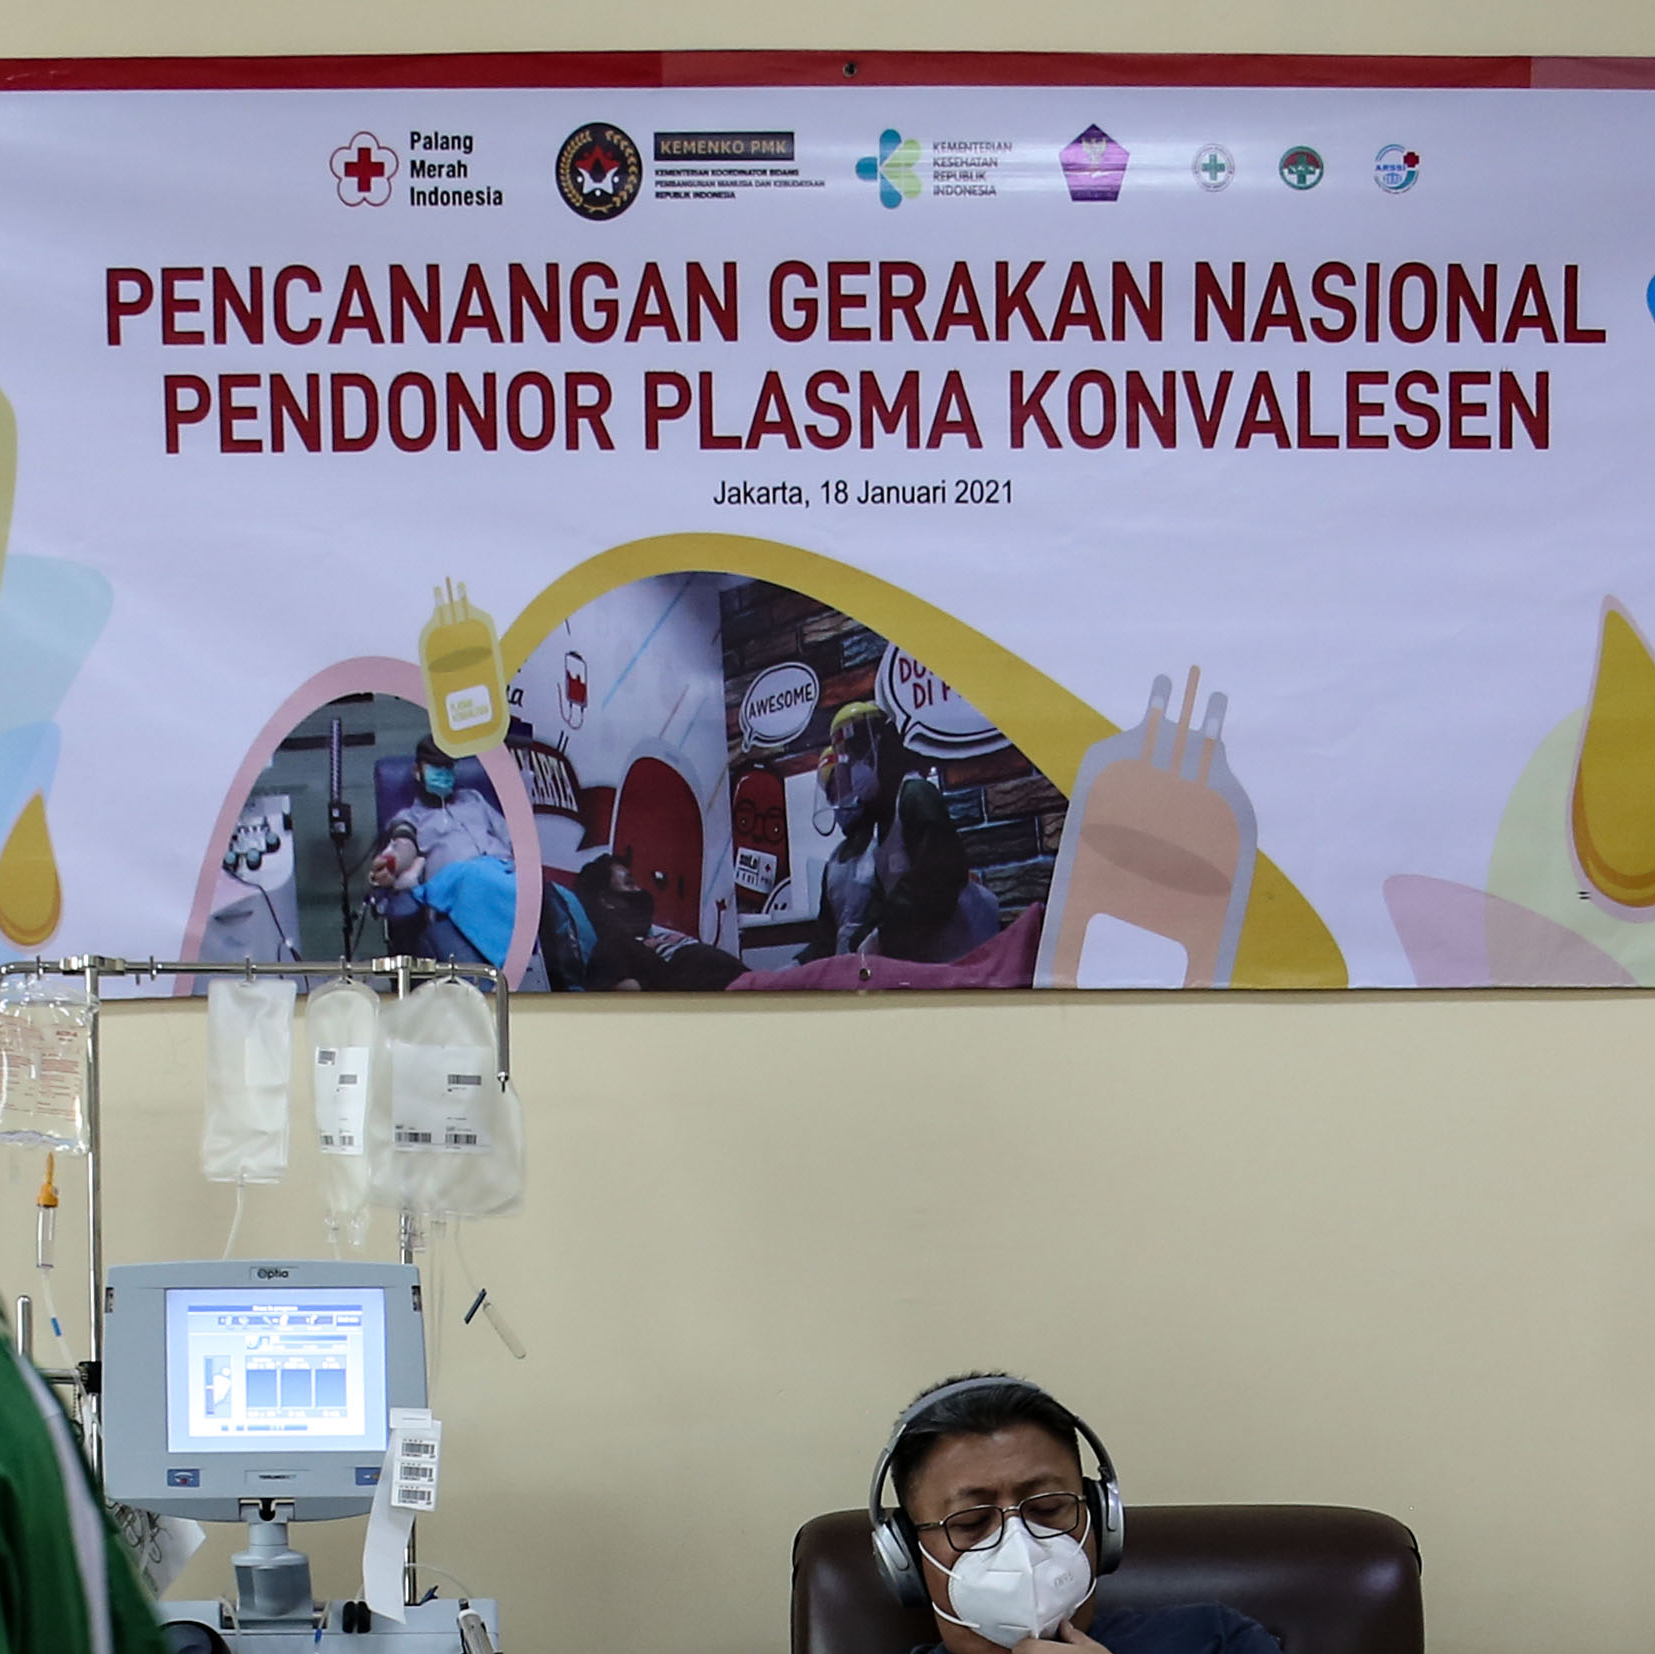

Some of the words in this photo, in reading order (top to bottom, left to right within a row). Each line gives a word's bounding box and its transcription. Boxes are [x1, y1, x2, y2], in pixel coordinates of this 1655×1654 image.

[410, 131, 474, 155] Palang
[660, 139, 745, 155] KEMENKO
[751, 139, 787, 154] PMK
[932, 142, 1013, 153] KEMENTERIAN
[410, 159, 468, 178] Merah
[933, 157, 998, 168] KESEHATAN
[933, 171, 987, 181] REPUBLIK
[410, 186, 504, 206] Indonesia
[933, 185, 997, 196] INDONESIA
[105, 261, 739, 346] PENCANANGAN
[769, 260, 1163, 343] GERAKAN
[1193, 261, 1607, 343] NASIONAL
[163, 370, 615, 454] PENDONOR
[644, 369, 983, 450] PLASMA
[1008, 369, 1550, 450] KONVALESEN
[713, 480, 810, 508] Jakarta,
[821, 480, 848, 505] 18
[857, 480, 946, 505] Januari
[954, 480, 1013, 504] 2021
[748, 683, 814, 719] AWESOME
[257, 1268, 290, 1280] Optia
